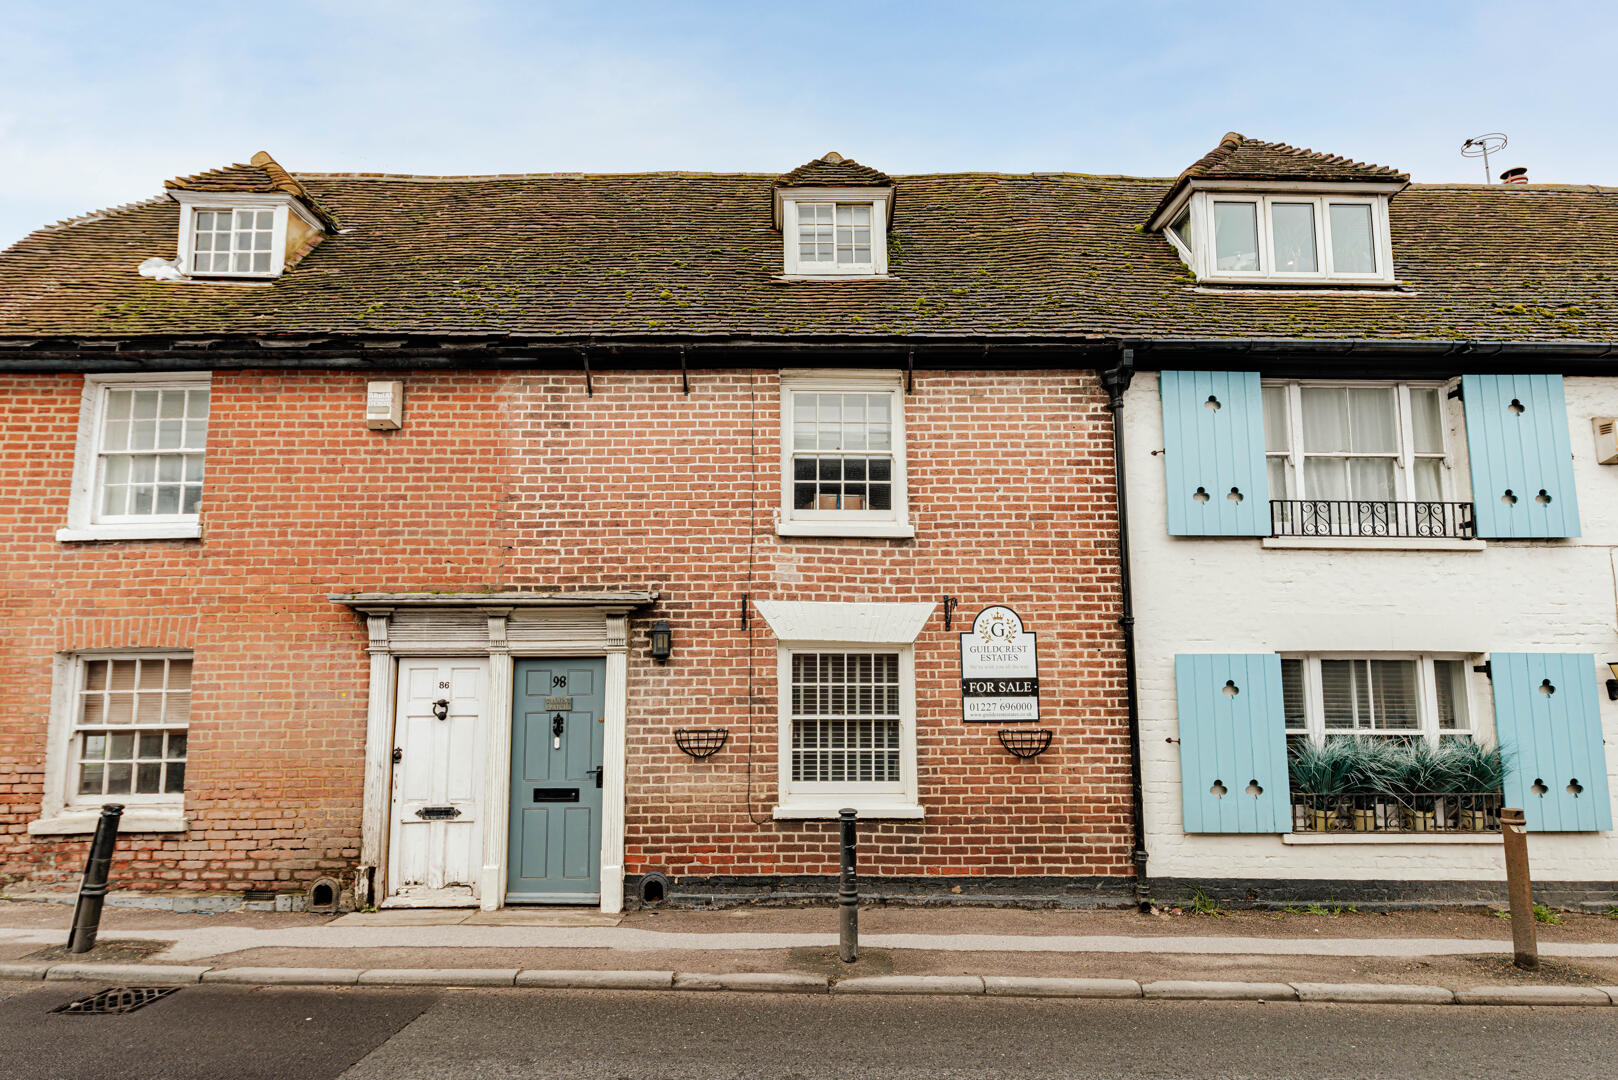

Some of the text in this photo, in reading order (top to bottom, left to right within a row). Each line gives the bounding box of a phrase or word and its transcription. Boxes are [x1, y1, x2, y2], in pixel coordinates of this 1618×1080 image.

[991, 621, 1005, 637] G
[969, 645, 1028, 654] GUILDCREST
[980, 654, 1019, 662] ESTATES
[438, 681, 450, 689] 86
[552, 675, 567, 688] 98
[969, 681, 1032, 693] FOR SALE
[969, 702, 1033, 711] 01227 696000
